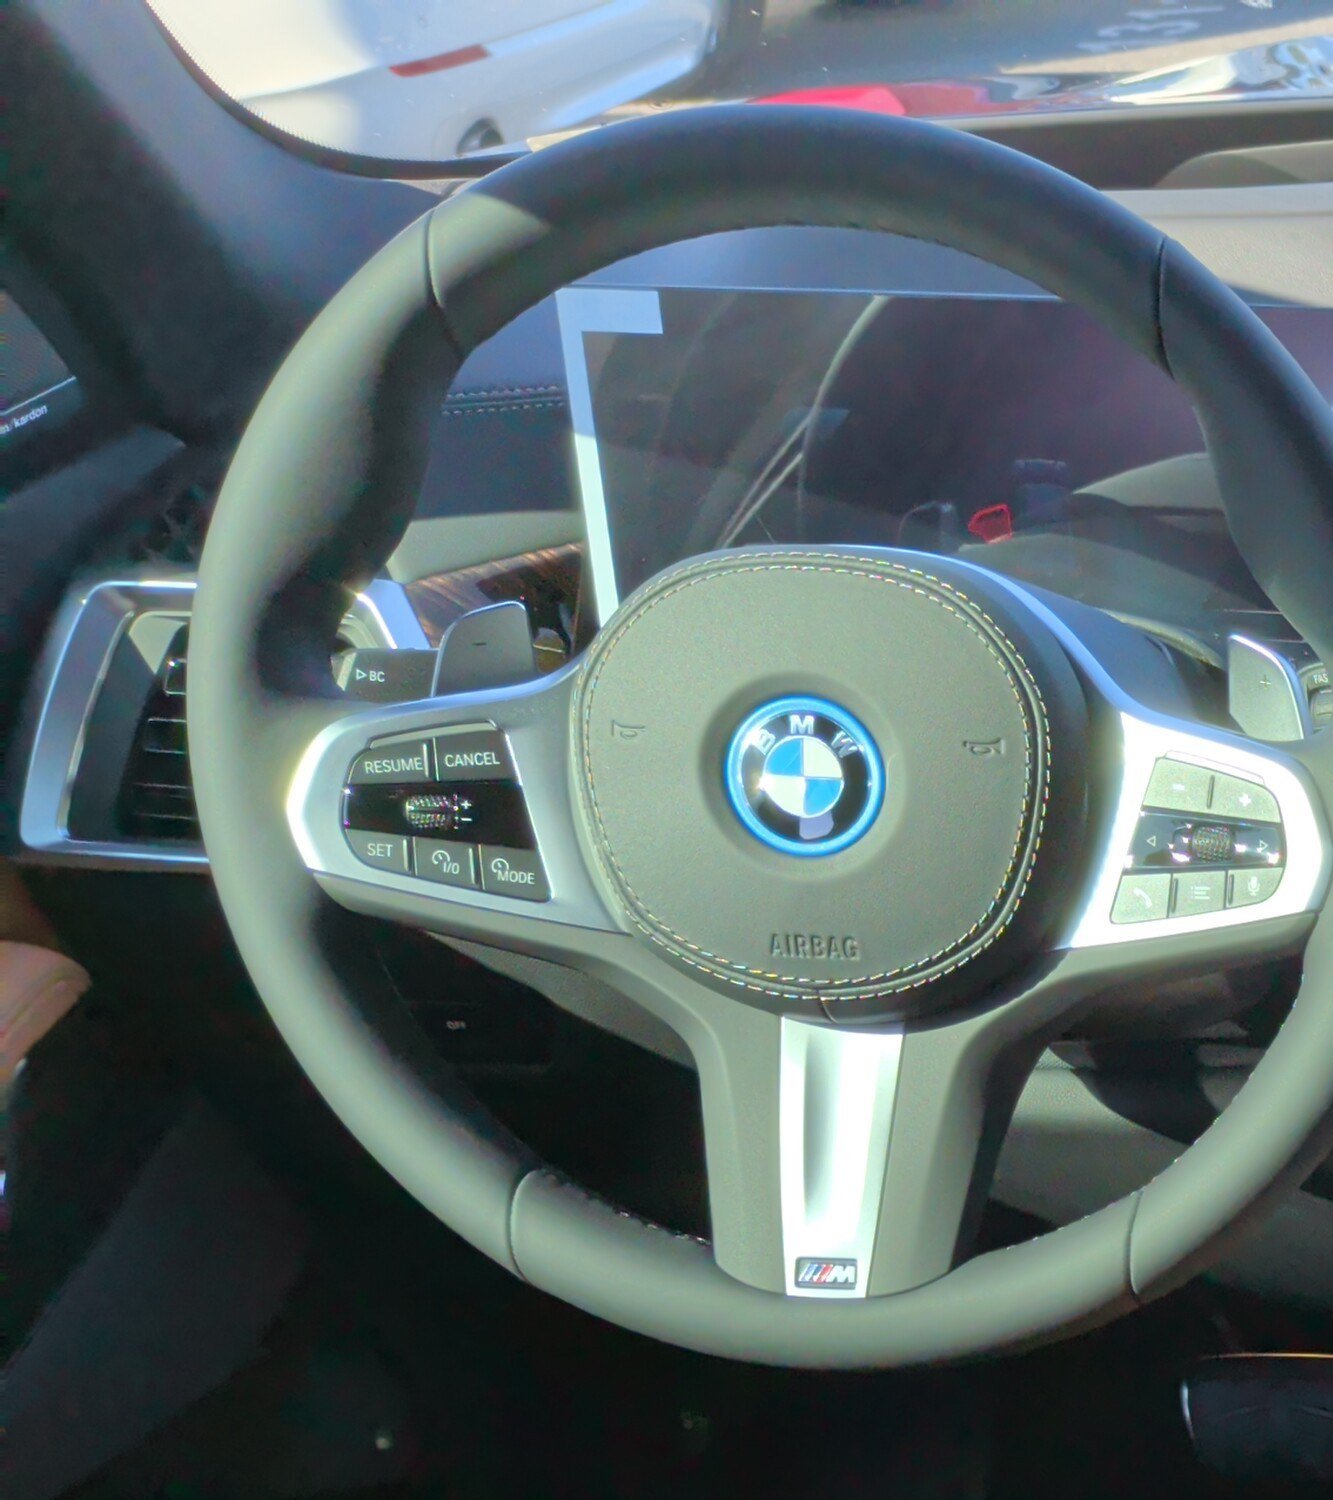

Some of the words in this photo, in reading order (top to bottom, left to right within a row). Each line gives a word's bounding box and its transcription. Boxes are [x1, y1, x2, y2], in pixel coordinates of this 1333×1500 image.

[369, 670, 386, 683] BC
[754, 714, 859, 760] BMW
[365, 756, 424, 774] RESUME
[444, 751, 501, 768] CANCEL
[367, 843, 394, 857] SET
[497, 871, 536, 886] MODE
[769, 932, 861, 960] AIRBAG
